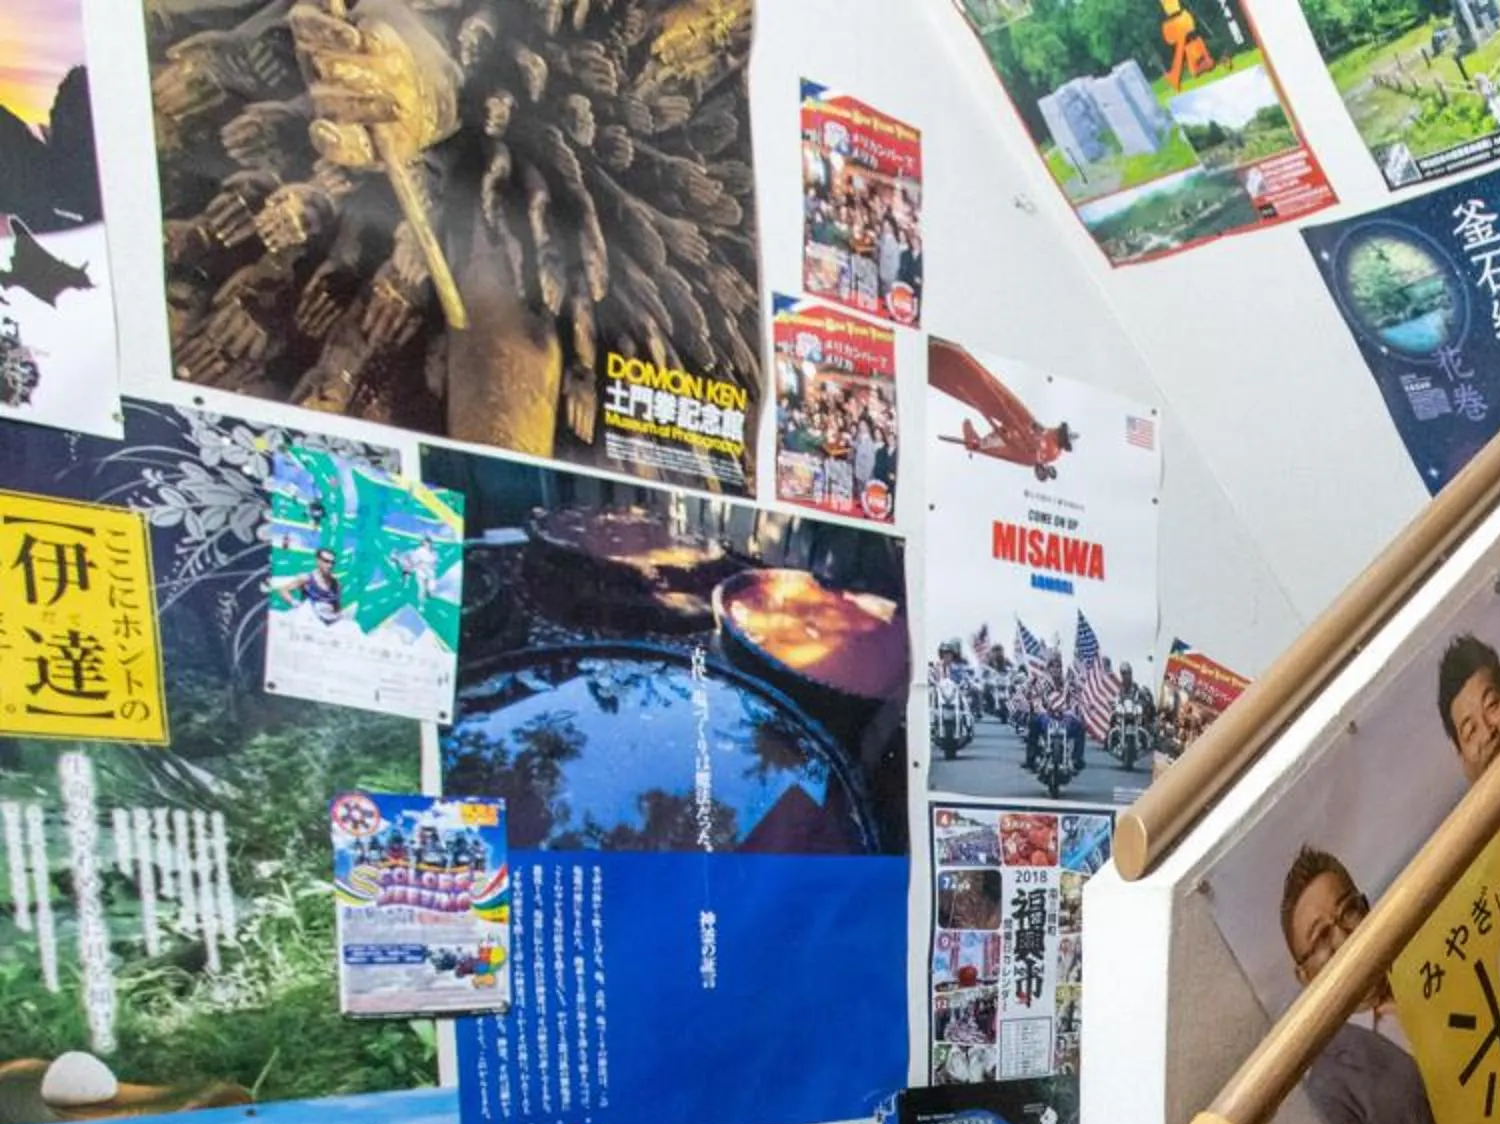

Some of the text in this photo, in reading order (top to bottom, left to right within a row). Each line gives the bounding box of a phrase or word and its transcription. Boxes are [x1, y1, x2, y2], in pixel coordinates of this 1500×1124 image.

[607, 351, 747, 410] DOMON KEN
[1431, 344, 1490, 424] 花巻
[992, 519, 1105, 582] MISAWA
[104, 529, 151, 722] ここにホントの
[1015, 870, 1048, 884] 2018
